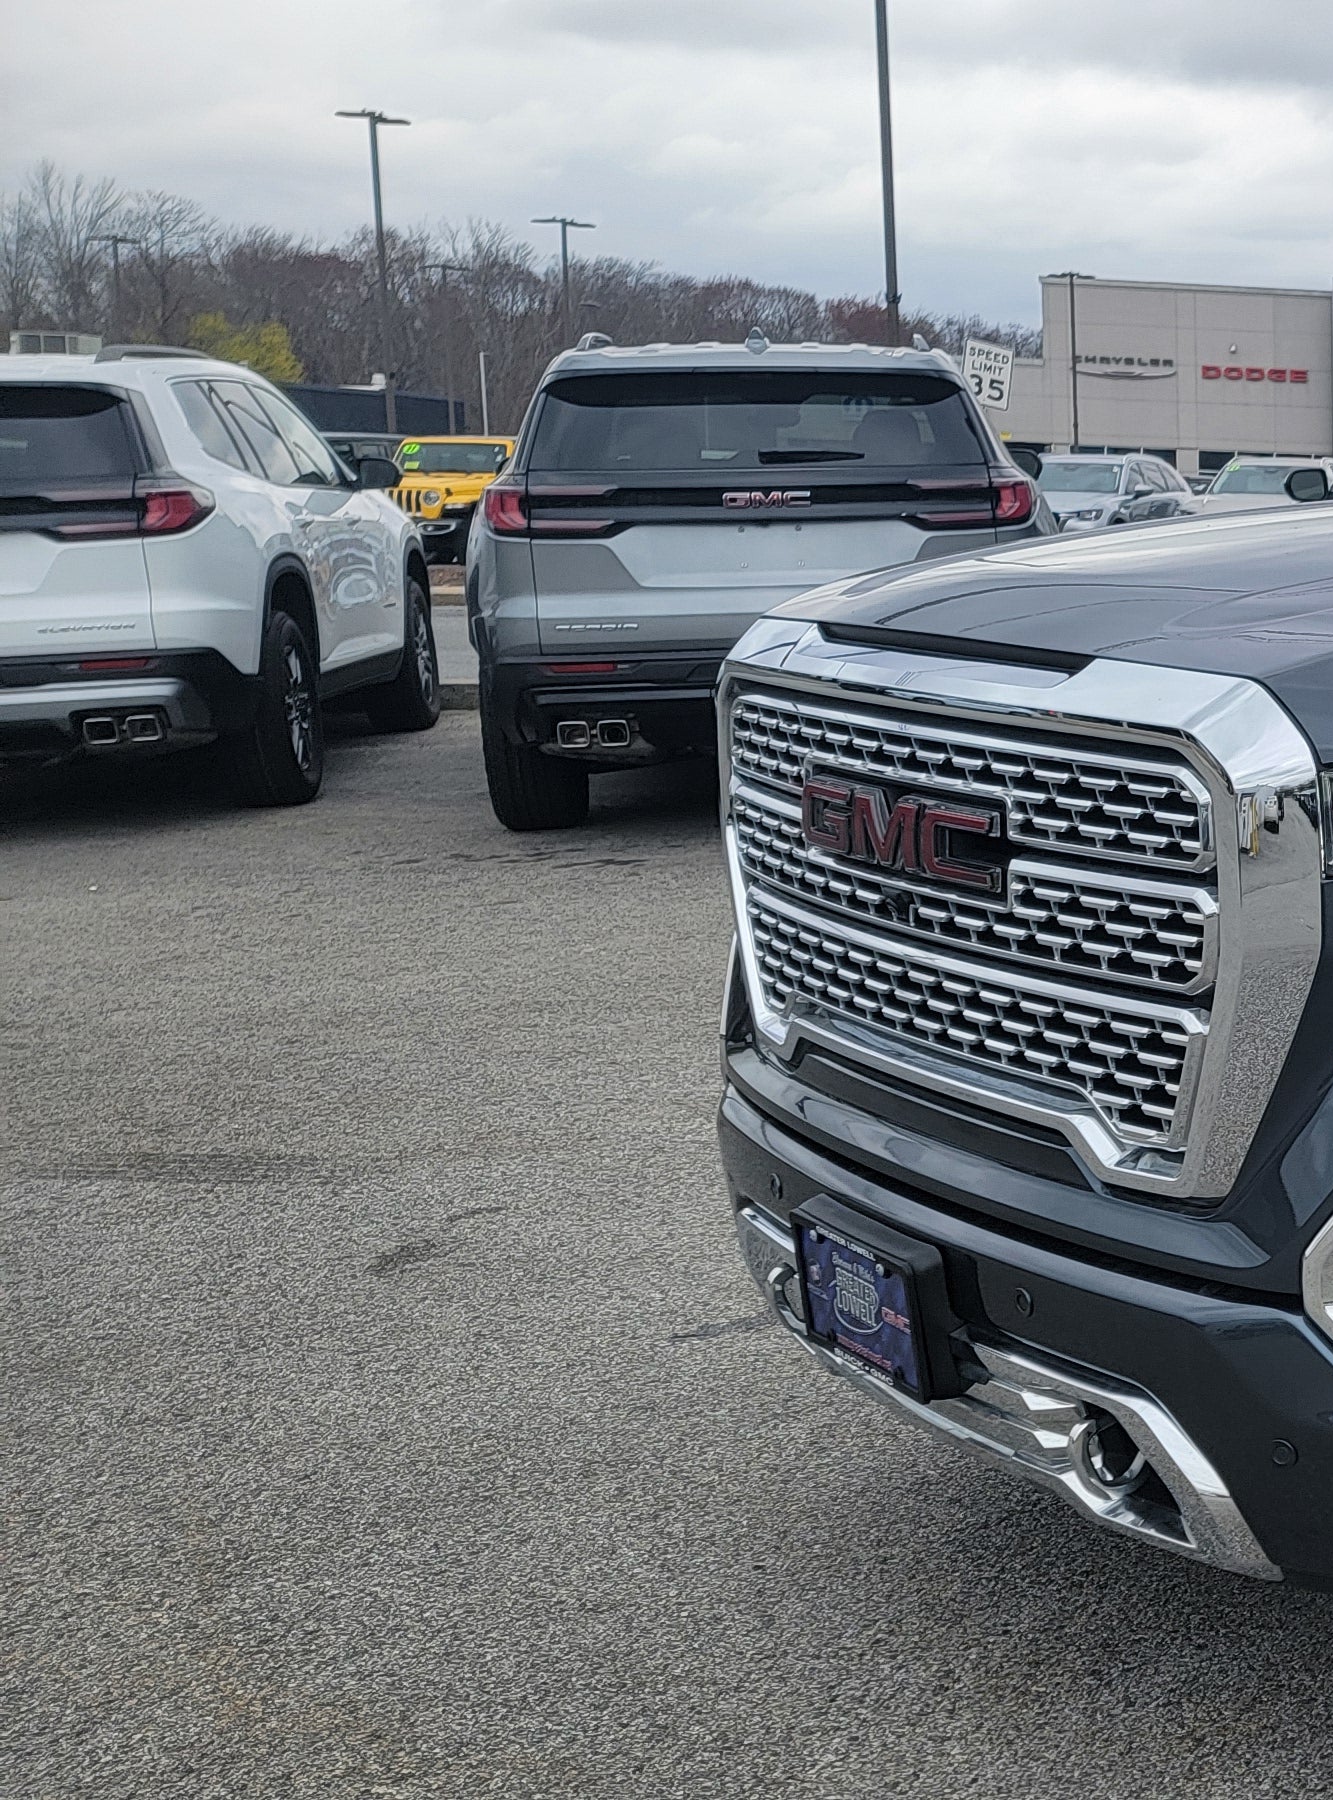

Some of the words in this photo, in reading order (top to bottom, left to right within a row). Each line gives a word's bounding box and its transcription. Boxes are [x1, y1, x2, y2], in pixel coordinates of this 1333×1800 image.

[969, 346, 1010, 365] SPEED
[1073, 355, 1174, 367] CHRYSLER
[972, 360, 1004, 377] LIMIT
[1201, 365, 1308, 384] DODGE
[970, 374, 1005, 402] 35
[722, 491, 812, 509] GMC
[802, 779, 1001, 893] GMC
[816, 1225, 846, 1246] GREATER
[847, 1240, 877, 1262] LOWELL
[835, 1286, 877, 1327] LOWELL
